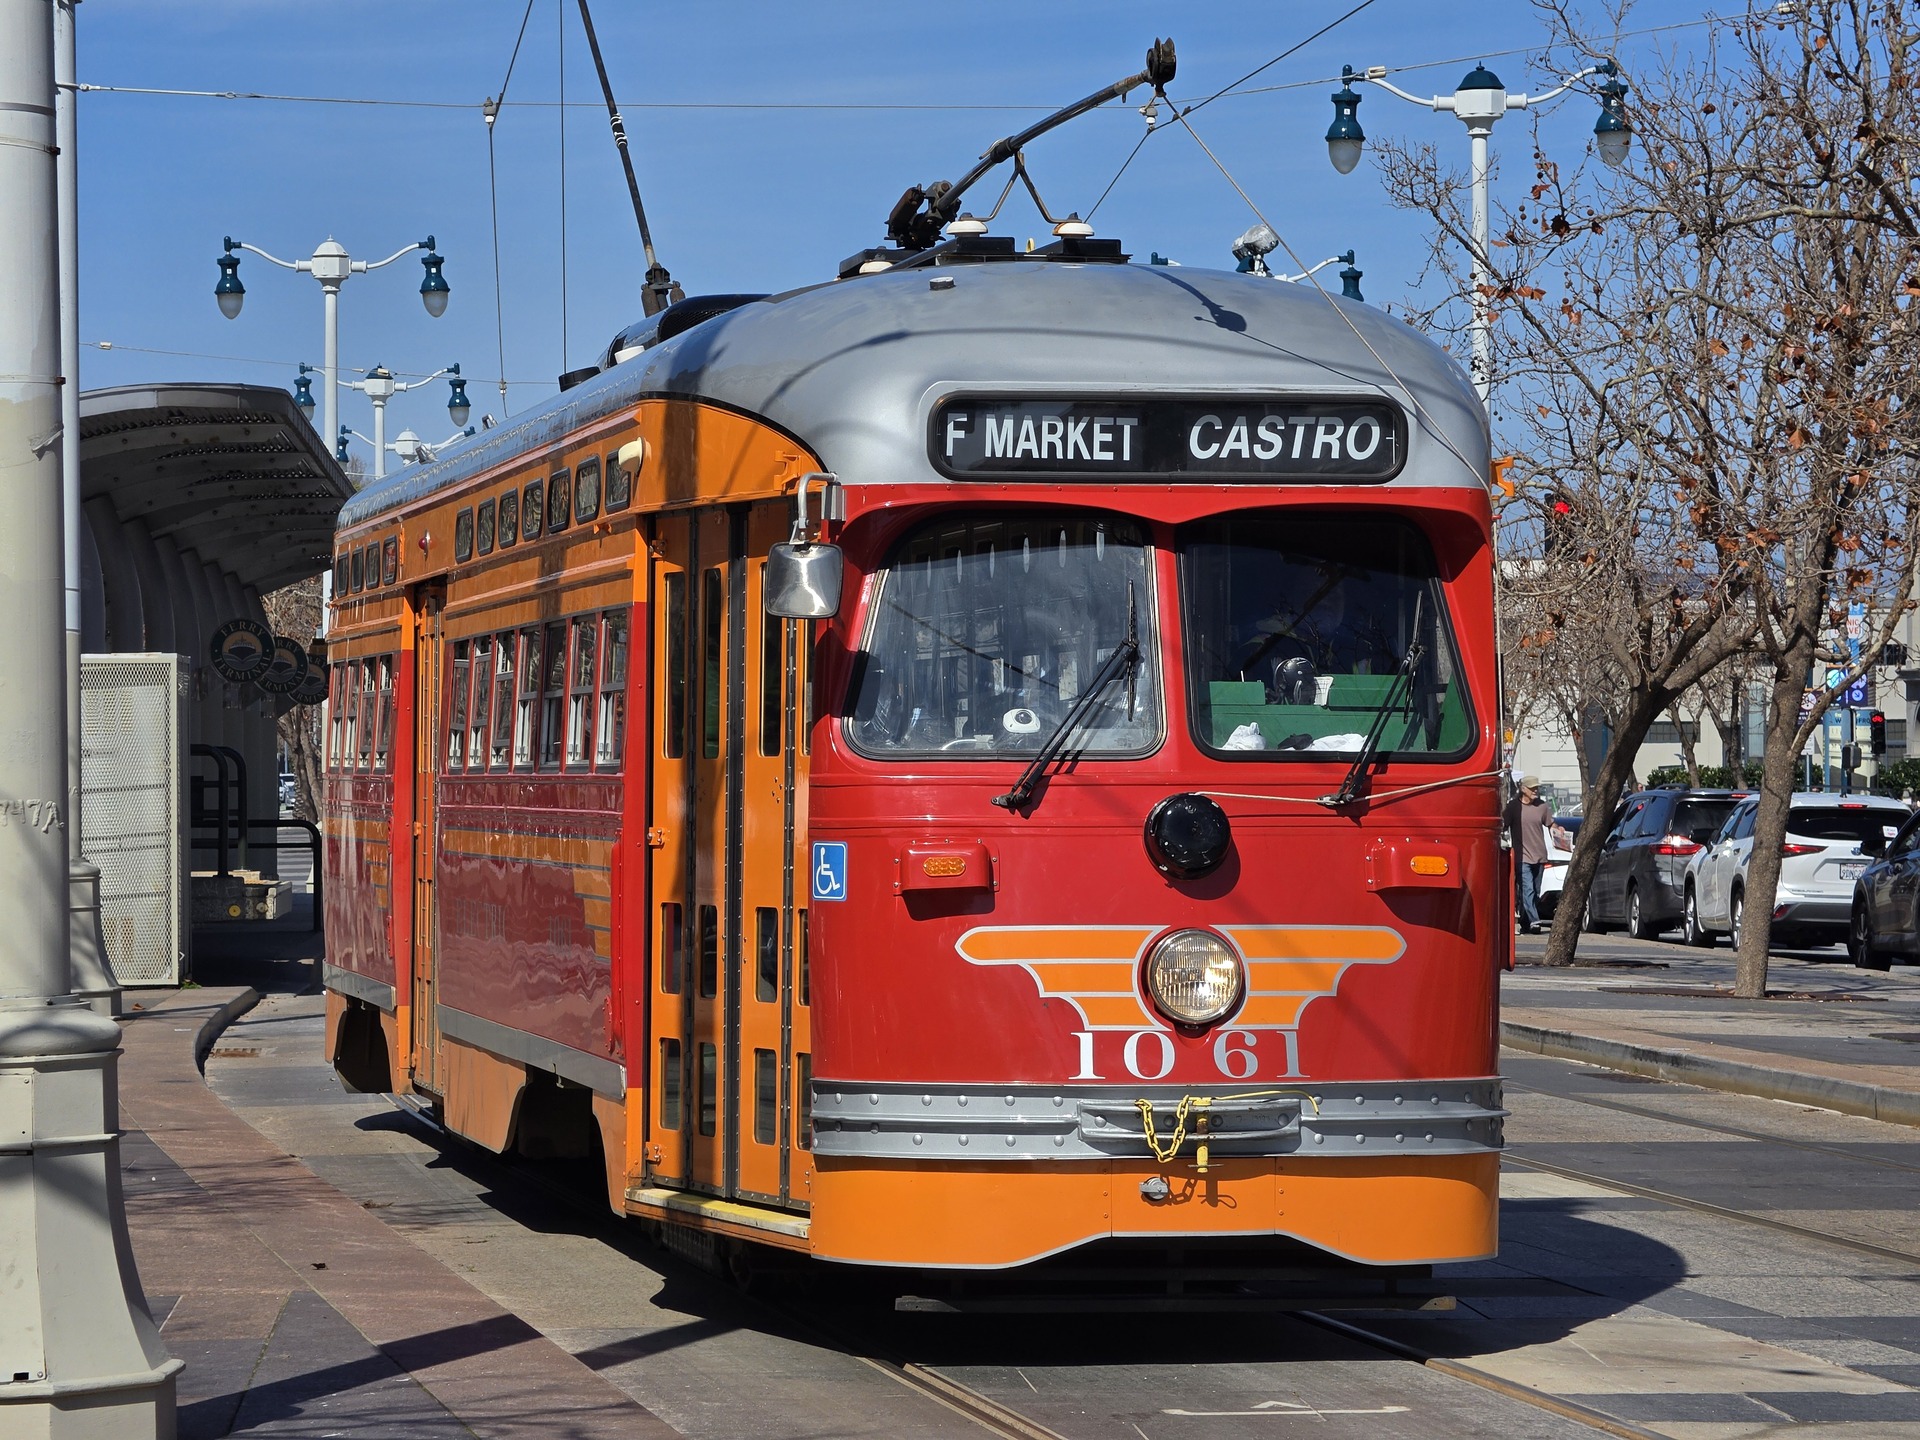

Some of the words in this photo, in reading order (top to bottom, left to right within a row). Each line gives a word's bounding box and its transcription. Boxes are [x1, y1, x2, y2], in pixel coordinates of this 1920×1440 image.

[945, 412, 968, 457] F
[984, 413, 1138, 462] MARKET
[1188, 413, 1381, 462] CASTRO
[221, 621, 265, 636] FERRY
[277, 639, 301, 653] RRY
[214, 654, 272, 680] TERMINAL
[260, 669, 305, 692] ERMINAL
